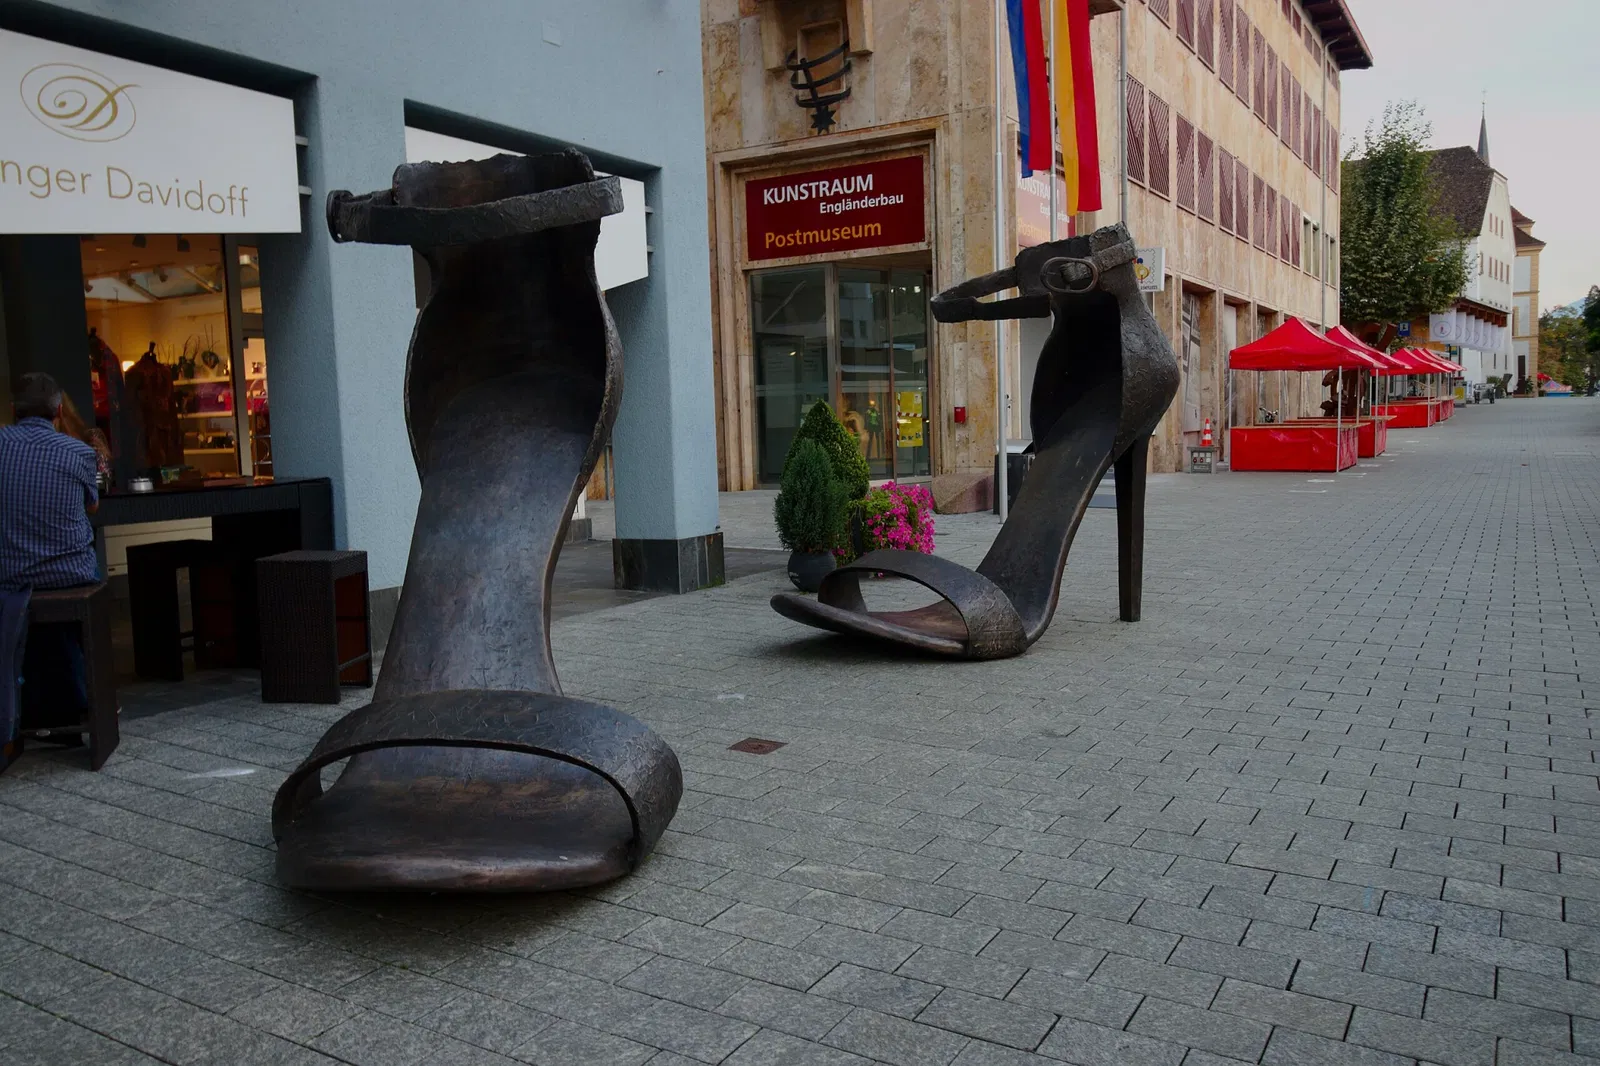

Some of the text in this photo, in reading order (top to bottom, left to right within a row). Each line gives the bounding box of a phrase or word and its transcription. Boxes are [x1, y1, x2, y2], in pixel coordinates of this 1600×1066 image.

[106, 165, 249, 217] Davidoff
[763, 173, 874, 205] KUNSTRAUM
[820, 194, 904, 215] Engländerbau
[765, 222, 882, 249] Postmuseum
